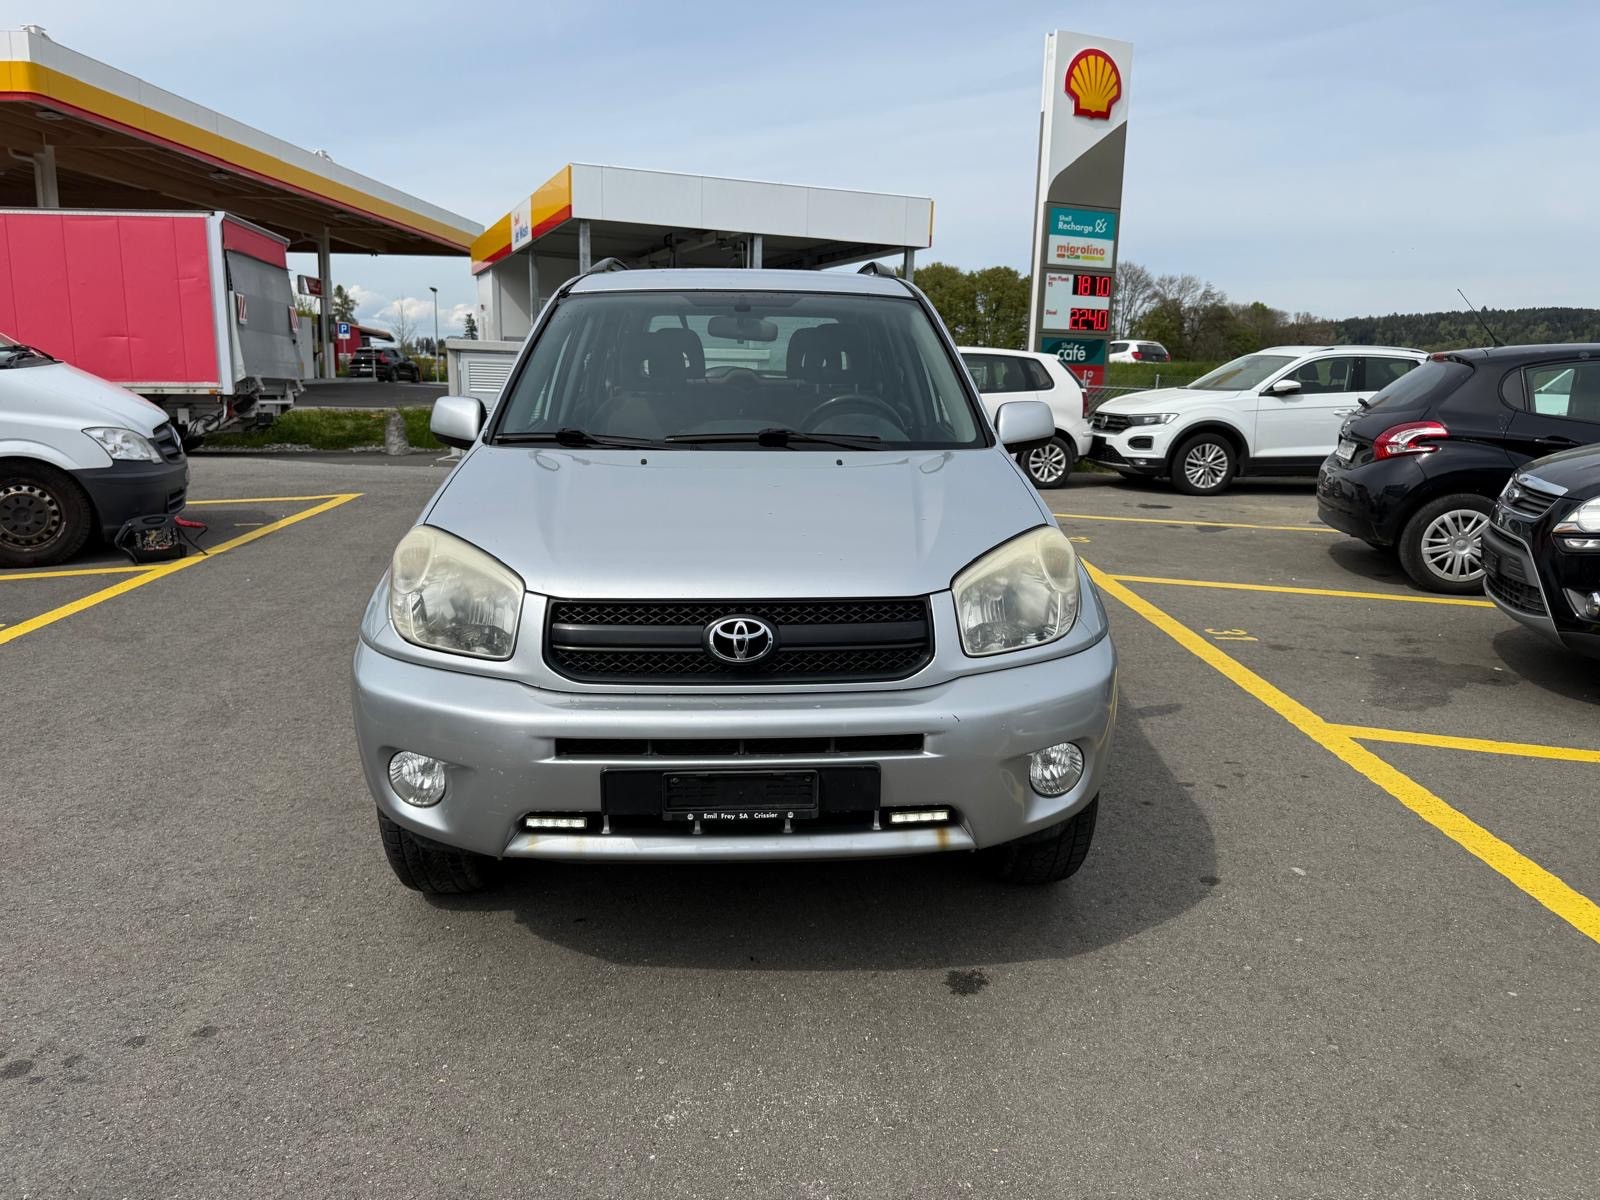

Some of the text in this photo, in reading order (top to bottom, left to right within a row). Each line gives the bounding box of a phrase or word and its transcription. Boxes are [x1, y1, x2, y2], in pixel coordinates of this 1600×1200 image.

[1057, 221, 1093, 234] Recharge
[1056, 243, 1105, 257] migrolino
[1057, 344, 1086, 361] café
[753, 811, 778, 819] Crissier
